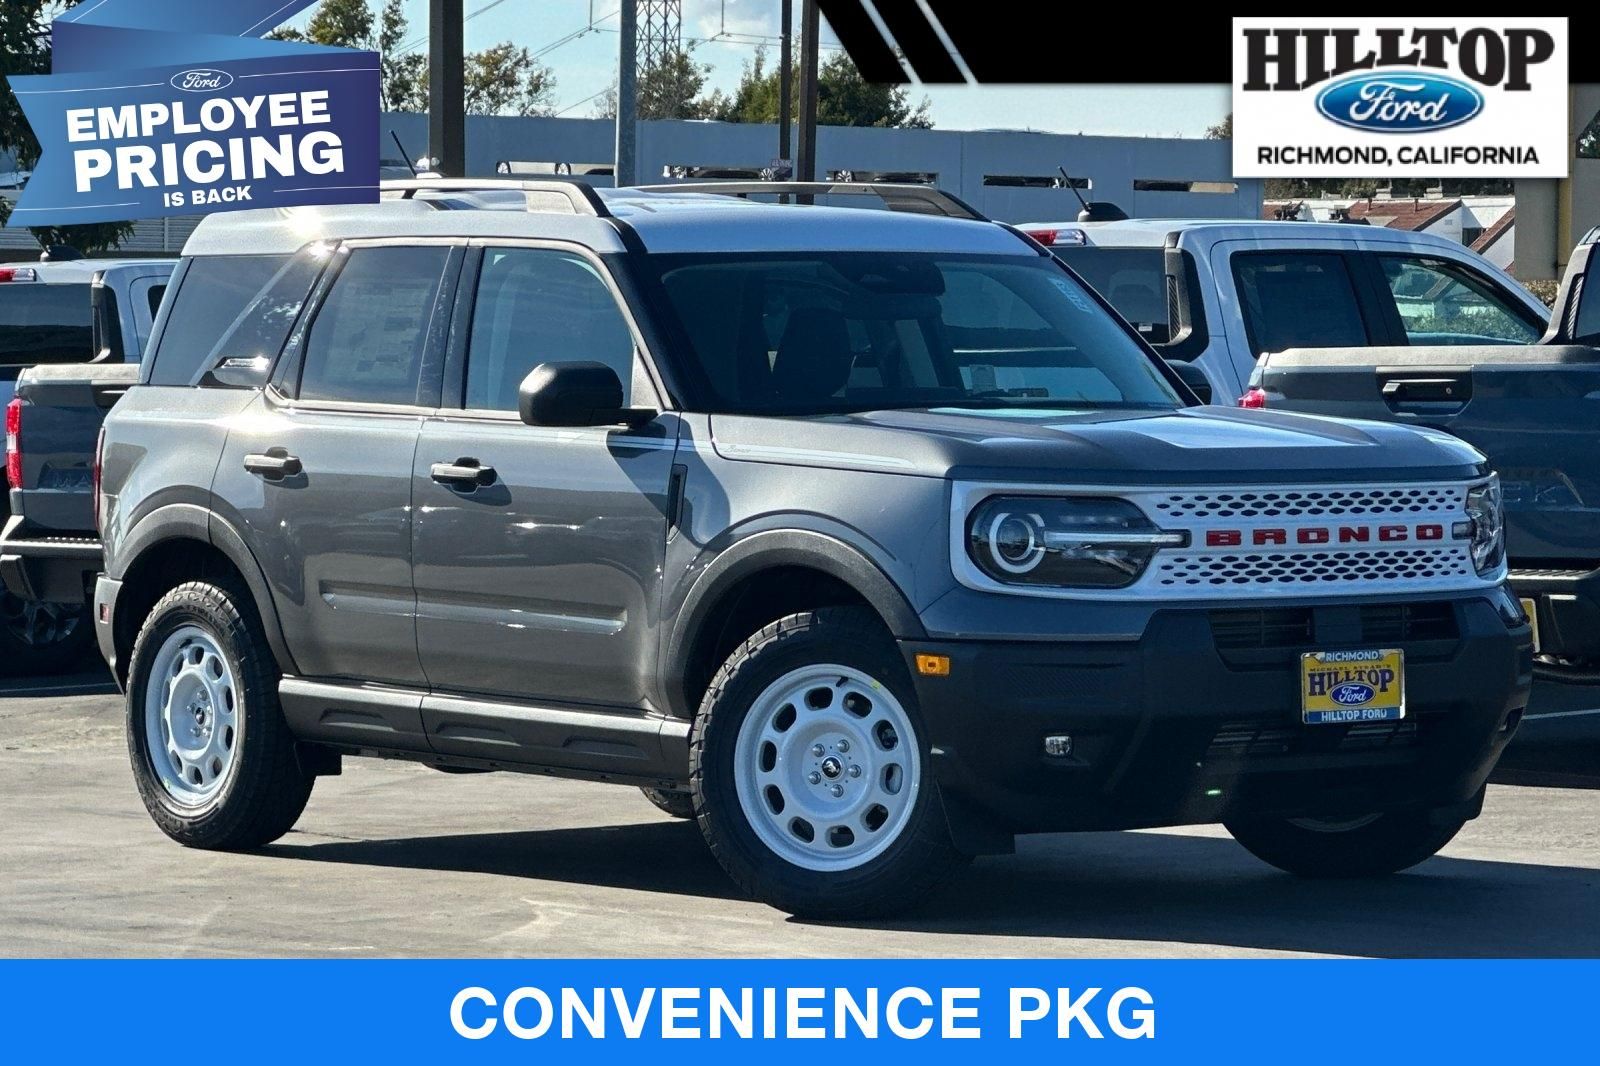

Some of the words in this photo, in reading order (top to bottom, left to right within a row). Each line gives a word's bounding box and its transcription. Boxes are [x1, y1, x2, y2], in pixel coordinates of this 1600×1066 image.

[1206, 524, 1443, 547] BRONCO
[1326, 651, 1378, 662] RICHMOND
[1308, 668, 1394, 696] HILLTOP
[1339, 686, 1367, 702] Ford
[1321, 710, 1360, 721] HILLTOP
[1362, 709, 1387, 719] FORD
